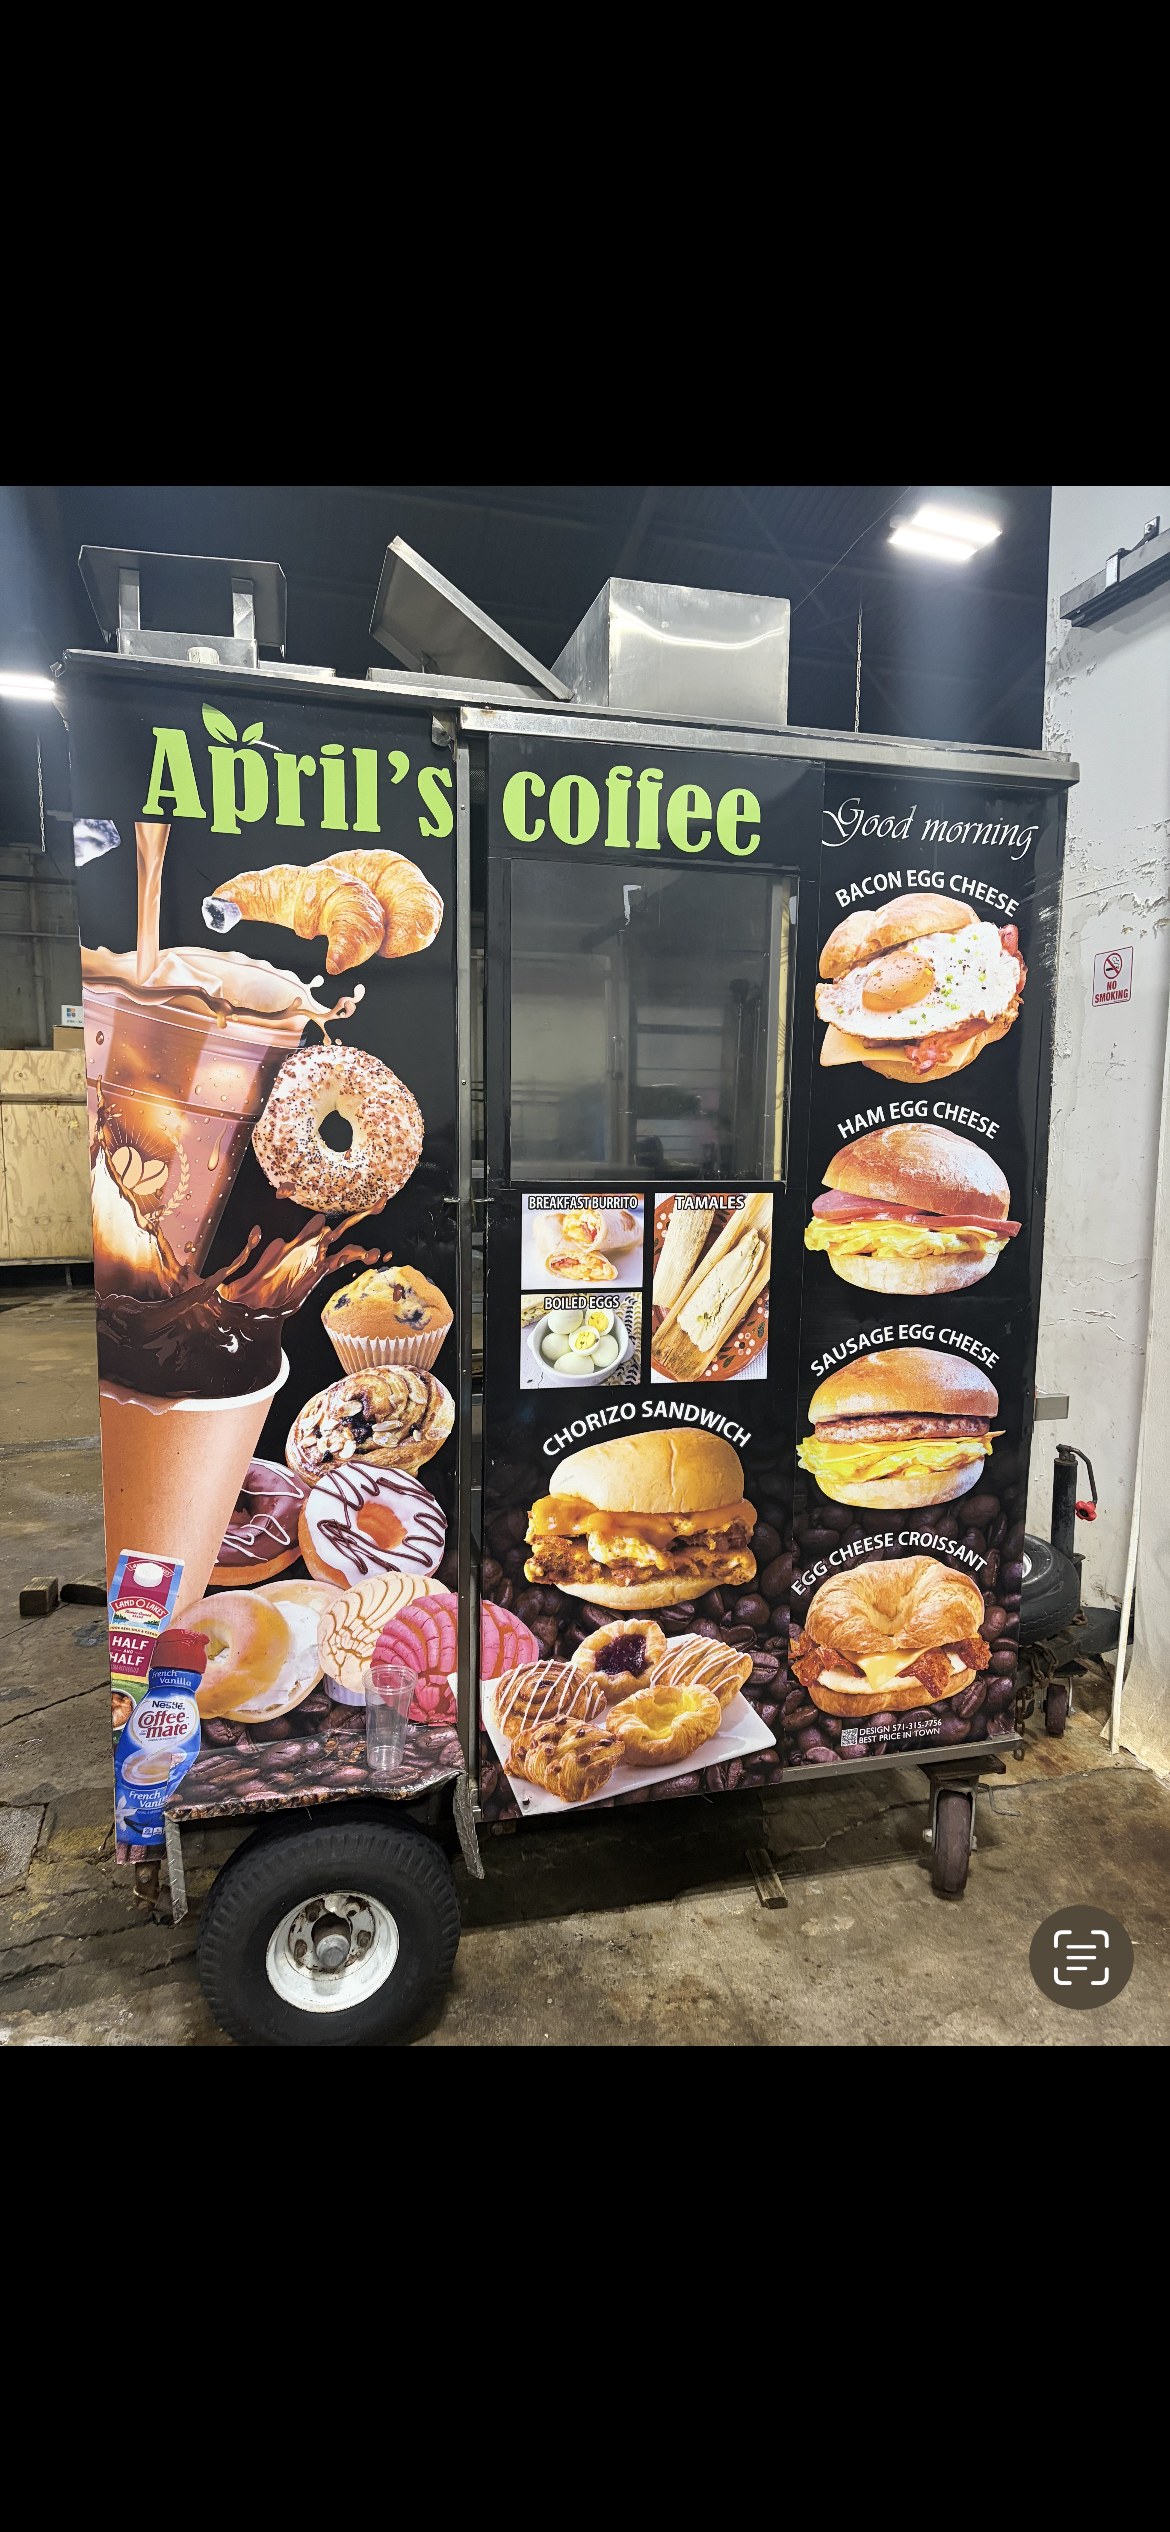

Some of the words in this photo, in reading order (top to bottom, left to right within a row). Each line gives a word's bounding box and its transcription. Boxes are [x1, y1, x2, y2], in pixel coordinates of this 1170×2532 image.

[142, 726, 455, 838] April's
[502, 765, 761, 857] coffee
[821, 797, 918, 847] Good
[921, 817, 1039, 861] morning
[835, 870, 902, 908] BACON
[906, 869, 945, 889] EGG
[949, 874, 1020, 917] CHEESE
[1106, 980, 1117, 991] NO
[1094, 989, 1129, 1004] SMOKING
[837, 1105, 886, 1139] HAM
[889, 1100, 928, 1120] EGG
[932, 1101, 1000, 1140] CHEESE
[528, 1196, 590, 1210] BREAKFAST
[592, 1195, 638, 1210] BURRITO
[675, 1195, 746, 1210] TAMALES
[544, 1297, 587, 1310] BOILED
[589, 1296, 620, 1310] EGGS
[810, 1326, 894, 1377] SAUSAGE
[898, 1324, 935, 1340] EGG
[938, 1328, 1000, 1369] CHEESE
[542, 1402, 636, 1457] CHORIZO
[641, 1400, 752, 1448] SANDWICH
[791, 1561, 828, 1596] EGG
[828, 1532, 894, 1566] CHEESE
[898, 1531, 988, 1572] CROISSANT
[114, 1599, 135, 1609] LAND
[146, 1602, 166, 1618] LAKES
[112, 1635, 149, 1651] HALF
[110, 1652, 145, 1666] HALF
[151, 1669, 177, 1679] French
[160, 1677, 192, 1687] Vanilla
[146, 1723, 188, 1738] mate
[859, 1725, 890, 1736] DESIGN
[892, 1719, 942, 1732] 571-315-7756
[859, 1735, 877, 1744] BEST
[879, 1732, 901, 1742] PRICE
[903, 1731, 912, 1739] IN
[914, 1728, 941, 1737] TOWN
[129, 1790, 161, 1800] French
